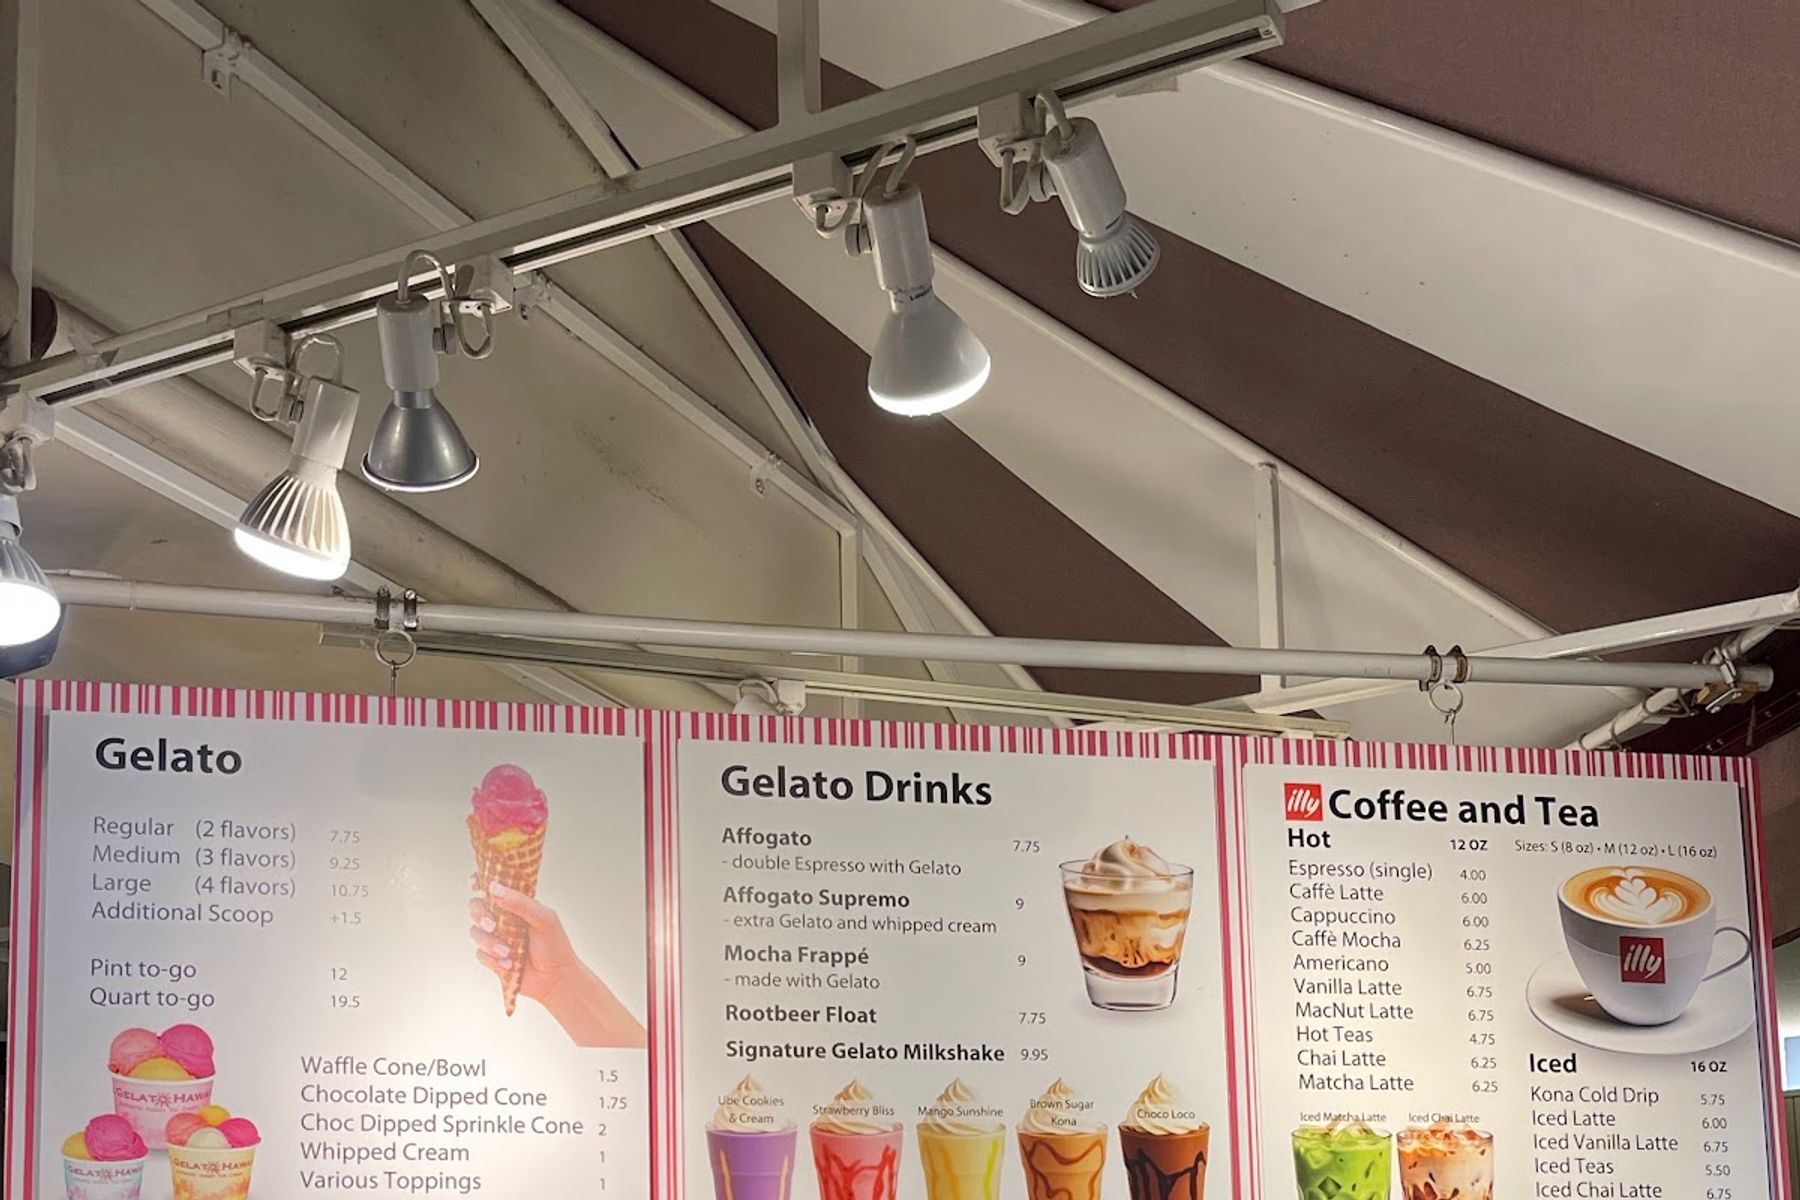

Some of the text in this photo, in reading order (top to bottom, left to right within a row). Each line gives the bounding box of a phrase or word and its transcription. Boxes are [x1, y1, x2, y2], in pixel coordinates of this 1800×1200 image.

[96, 738, 242, 774] Gelato
[722, 765, 992, 805] Gelato Drinks
[1287, 786, 1320, 817] illy
[1329, 789, 1598, 827] Coffee and Tea
[94, 816, 360, 847] Regular (2 flavors) 7.75
[722, 827, 1040, 853] Affogato 7.75
[1288, 828, 1487, 851] Hot 12 OZ
[93, 845, 360, 871] Medium (3 flavors) 9.25
[732, 853, 961, 875] double Espresso with Gelato
[1289, 859, 1486, 883] Espresso (single) 4.00
[93, 873, 369, 898] Large (4 flavors) 10.75
[1290, 882, 1487, 904] Caffè Latte 6.00
[723, 886, 1024, 910] Affogato Supremo 9
[92, 901, 361, 927] Additional Scoop +1.5
[734, 912, 996, 935] extra Gelato and whipped cream
[1291, 906, 1489, 928] Cappuccino 6.00
[1292, 930, 1489, 951] Caffè Mocha 6.25
[725, 945, 1026, 968] Mocha Frappé 9
[1293, 954, 1492, 975] Americano 5.00
[1623, 944, 1663, 979] illy
[92, 959, 347, 982] Pint to-go 12
[735, 971, 880, 989] made with Gelato
[90, 987, 360, 1011] Quart to-go 19.5
[1293, 978, 1492, 998] Vanilla Latte 6.75
[726, 1005, 1046, 1024] Rootbeer Float 7.75
[1296, 1002, 1494, 1021] MacNut Latte 6.75
[1297, 1026, 1495, 1045] Hot Teas 4.75
[727, 1041, 1048, 1061] Signature Gelato Milkshake 9.95
[1297, 1049, 1496, 1069] Chai Latte 6.25
[301, 1056, 618, 1083] Waffle Cone/Bowl 1.5
[1530, 1053, 1727, 1073] Iced 16 OZ
[1299, 1073, 1498, 1093] Matcha Latte 6.25
[301, 1084, 627, 1110] Chocolate Dipped Cone 1.75
[718, 1094, 785, 1107] Ube Cookies
[1030, 1099, 1095, 1112] Brown Sugar
[1531, 1086, 1725, 1108] Kona Cold Drip 5.75
[742, 1113, 774, 1124] Cream
[813, 1104, 894, 1119] Strawberry Bliss
[917, 1105, 1004, 1119] Mango Sunshine
[1051, 1115, 1077, 1127] Kona
[1137, 1108, 1195, 1121] Choco Loco
[1300, 1112, 1386, 1123] Iced Matcha Latte
[1408, 1113, 1480, 1124] Iced Chai Latte
[1533, 1109, 1727, 1129] Iced Latte 6.00
[301, 1112, 583, 1137] Choc Dipped Sprinkle Cone
[300, 1141, 469, 1165] Whipped Cream
[1534, 1133, 1728, 1153] Iced Vanilla Latte 6.75
[1535, 1157, 1730, 1176] Iced Teas 5.50
[300, 1171, 481, 1194] Various Toppings
[1536, 1181, 1732, 1200] Iced Chai Latte 6.75
